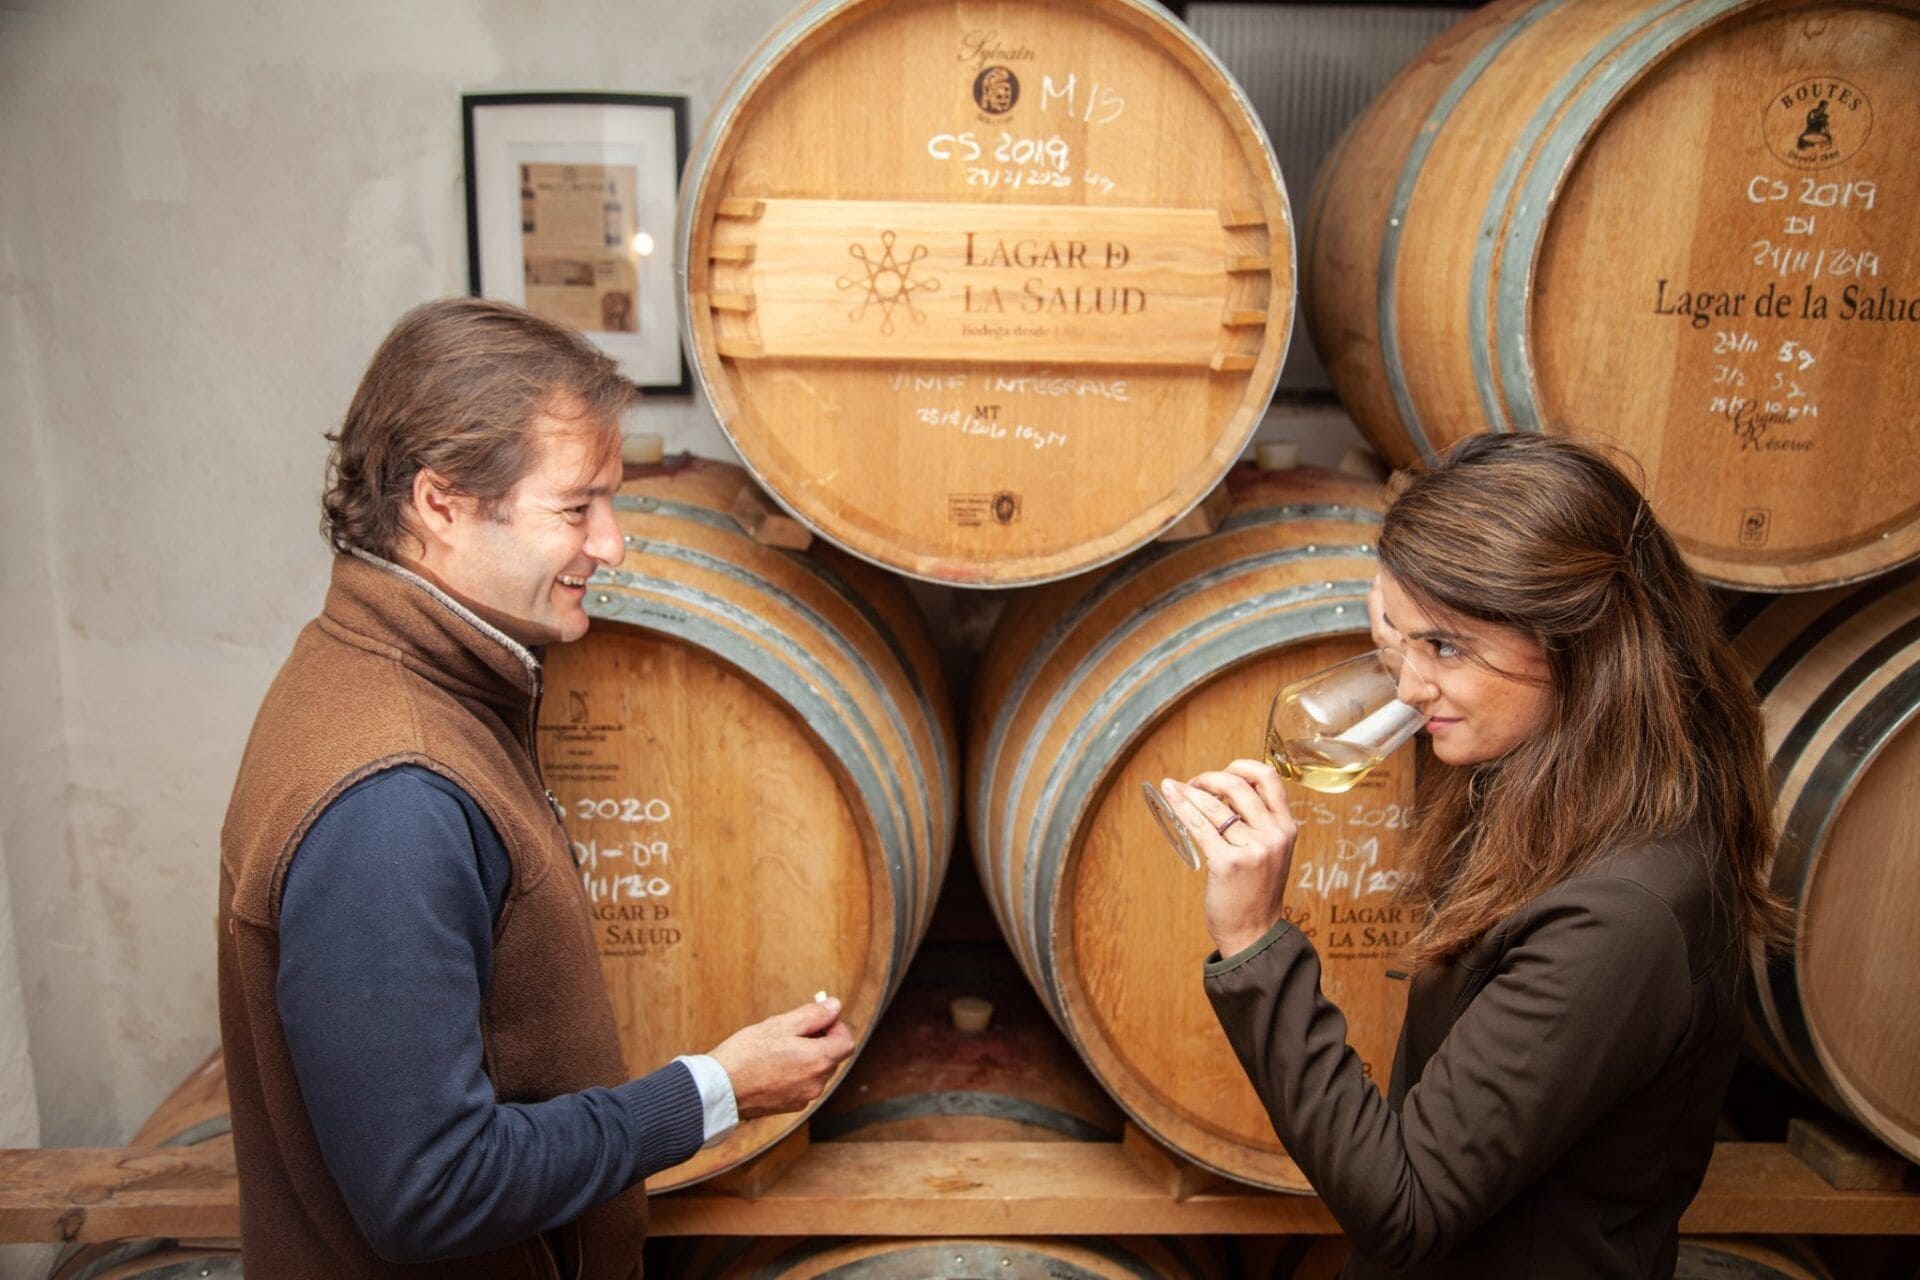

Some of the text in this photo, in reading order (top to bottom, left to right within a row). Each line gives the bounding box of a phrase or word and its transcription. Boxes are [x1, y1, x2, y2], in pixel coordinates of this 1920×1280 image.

[1779, 82, 1864, 112] BOUTES
[927, 132, 1070, 173] CS 2019
[1747, 175, 1877, 210] CS 2019
[964, 231, 1087, 269] LAGAR
[962, 277, 1147, 315] LA SALUD
[1654, 279, 1746, 329] Lagar
[1754, 282, 1792, 319] de
[1800, 284, 1829, 319] la
[974, 404, 1001, 420] MT
[575, 797, 672, 823] 2020
[591, 904, 645, 921] AGAR
[1330, 905, 1402, 924] LAGAR
[606, 924, 682, 945] SALUD
[1328, 931, 1354, 948] LA
